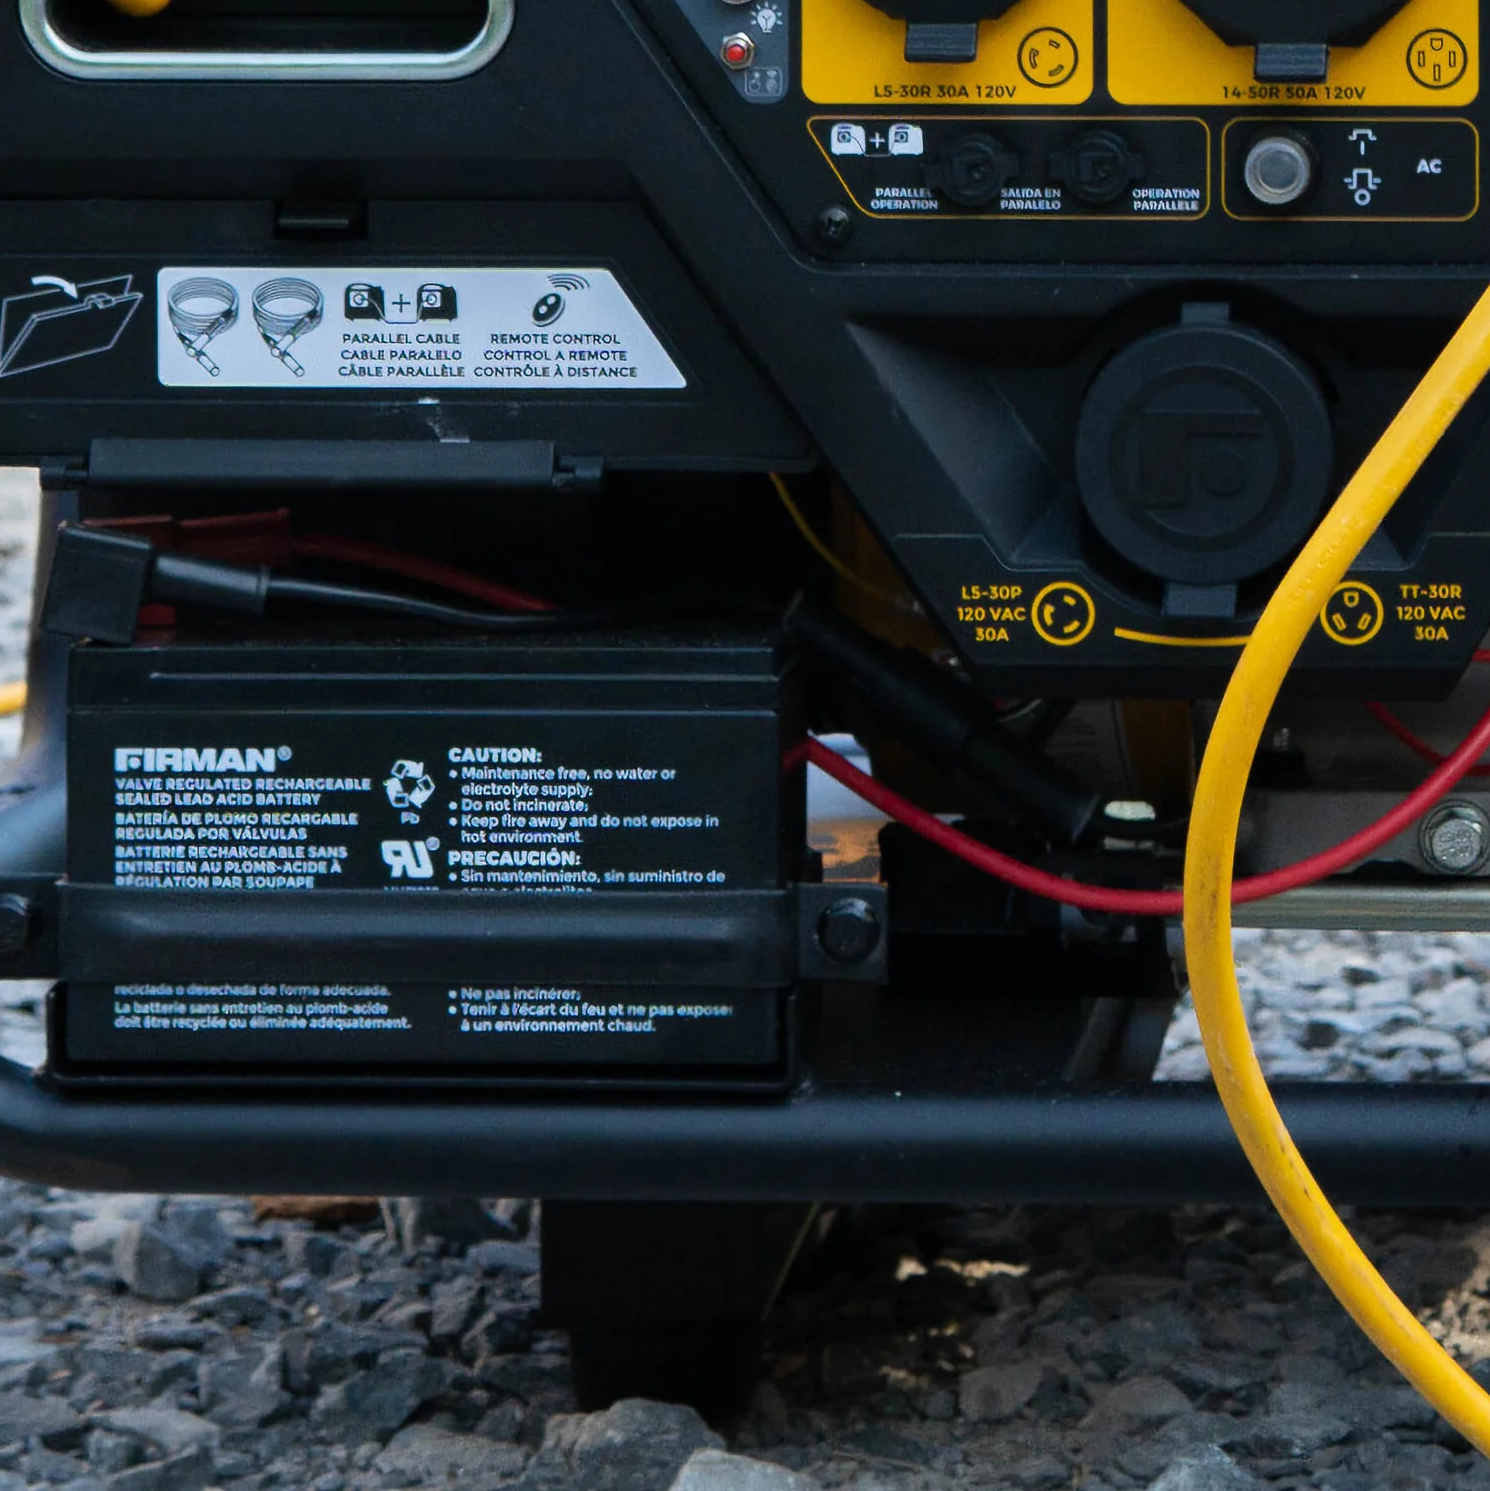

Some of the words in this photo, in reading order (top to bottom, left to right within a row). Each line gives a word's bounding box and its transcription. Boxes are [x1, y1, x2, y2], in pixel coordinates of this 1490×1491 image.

[1417, 159, 1441, 173] AC
[343, 334, 411, 343] PARALLEL
[416, 334, 459, 344] CABLE
[492, 334, 548, 344] REMOTE
[553, 334, 620, 344] CONTROL
[484, 350, 550, 360] CONTROL
[556, 351, 564, 360] A
[570, 351, 626, 361] REMOTE
[474, 364, 549, 376] CONTRÔLE
[554, 364, 562, 376] À
[568, 367, 636, 377] DISTANCE
[962, 586, 1022, 599] L5-30P
[1400, 585, 1461, 598] TT-30R
[958, 607, 985, 621] 120
[990, 607, 1026, 621] VAC
[1397, 606, 1424, 620] 120
[1429, 606, 1465, 620] VAC
[976, 627, 1009, 641] 30A
[1415, 626, 1449, 640] 30A
[449, 748, 542, 763] CAUTION:
[448, 848, 581, 866] PRECAUCIÓN:
